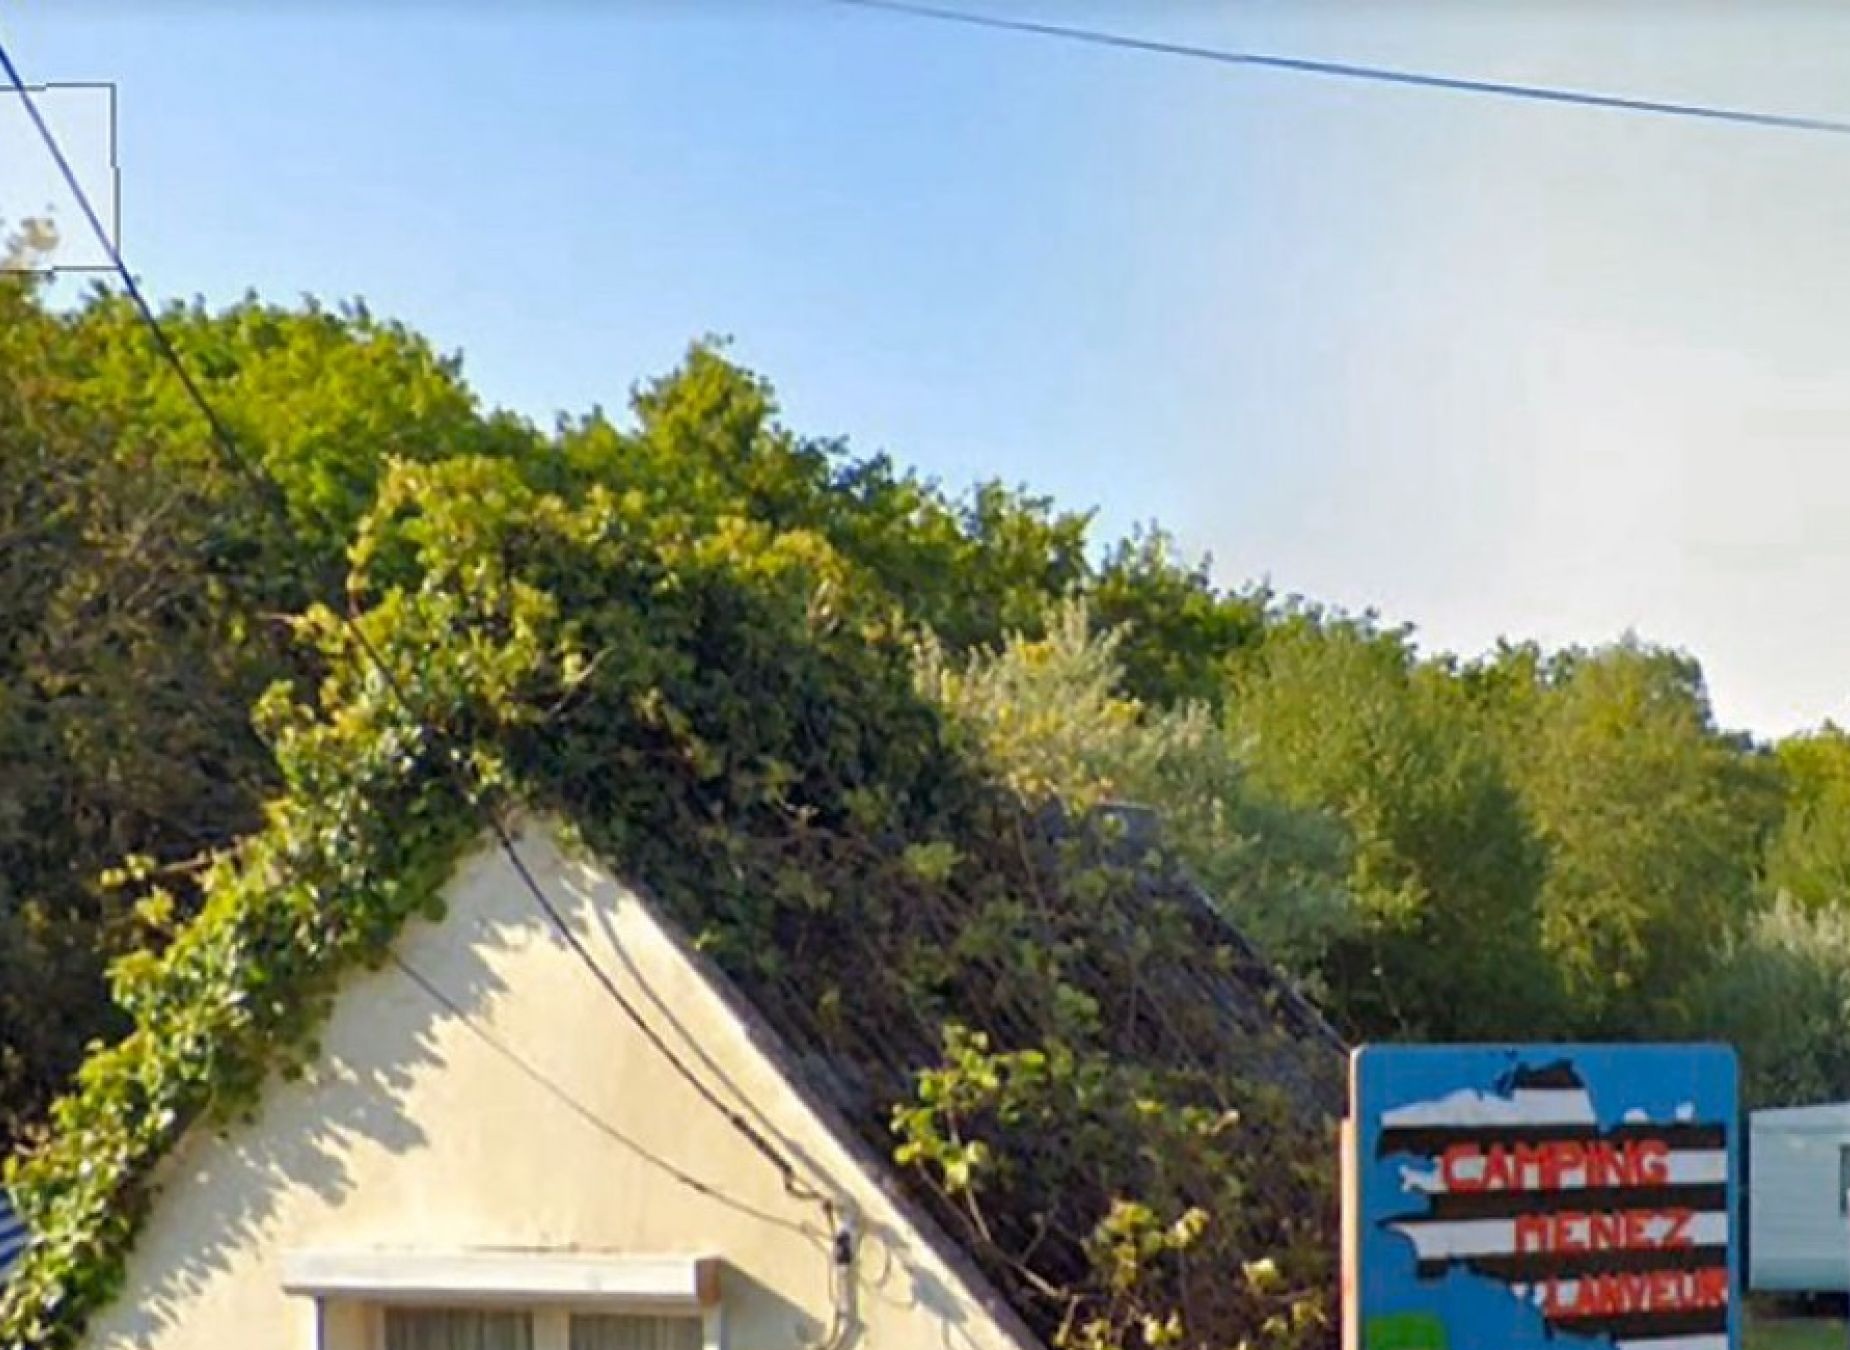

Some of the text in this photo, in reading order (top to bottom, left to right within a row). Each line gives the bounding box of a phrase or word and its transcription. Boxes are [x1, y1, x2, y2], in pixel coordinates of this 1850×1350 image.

[1441, 1140, 1669, 1194] CAMPING
[1514, 1208, 1694, 1256] MENEZ
[1544, 1266, 1728, 1320] LANVEUR
